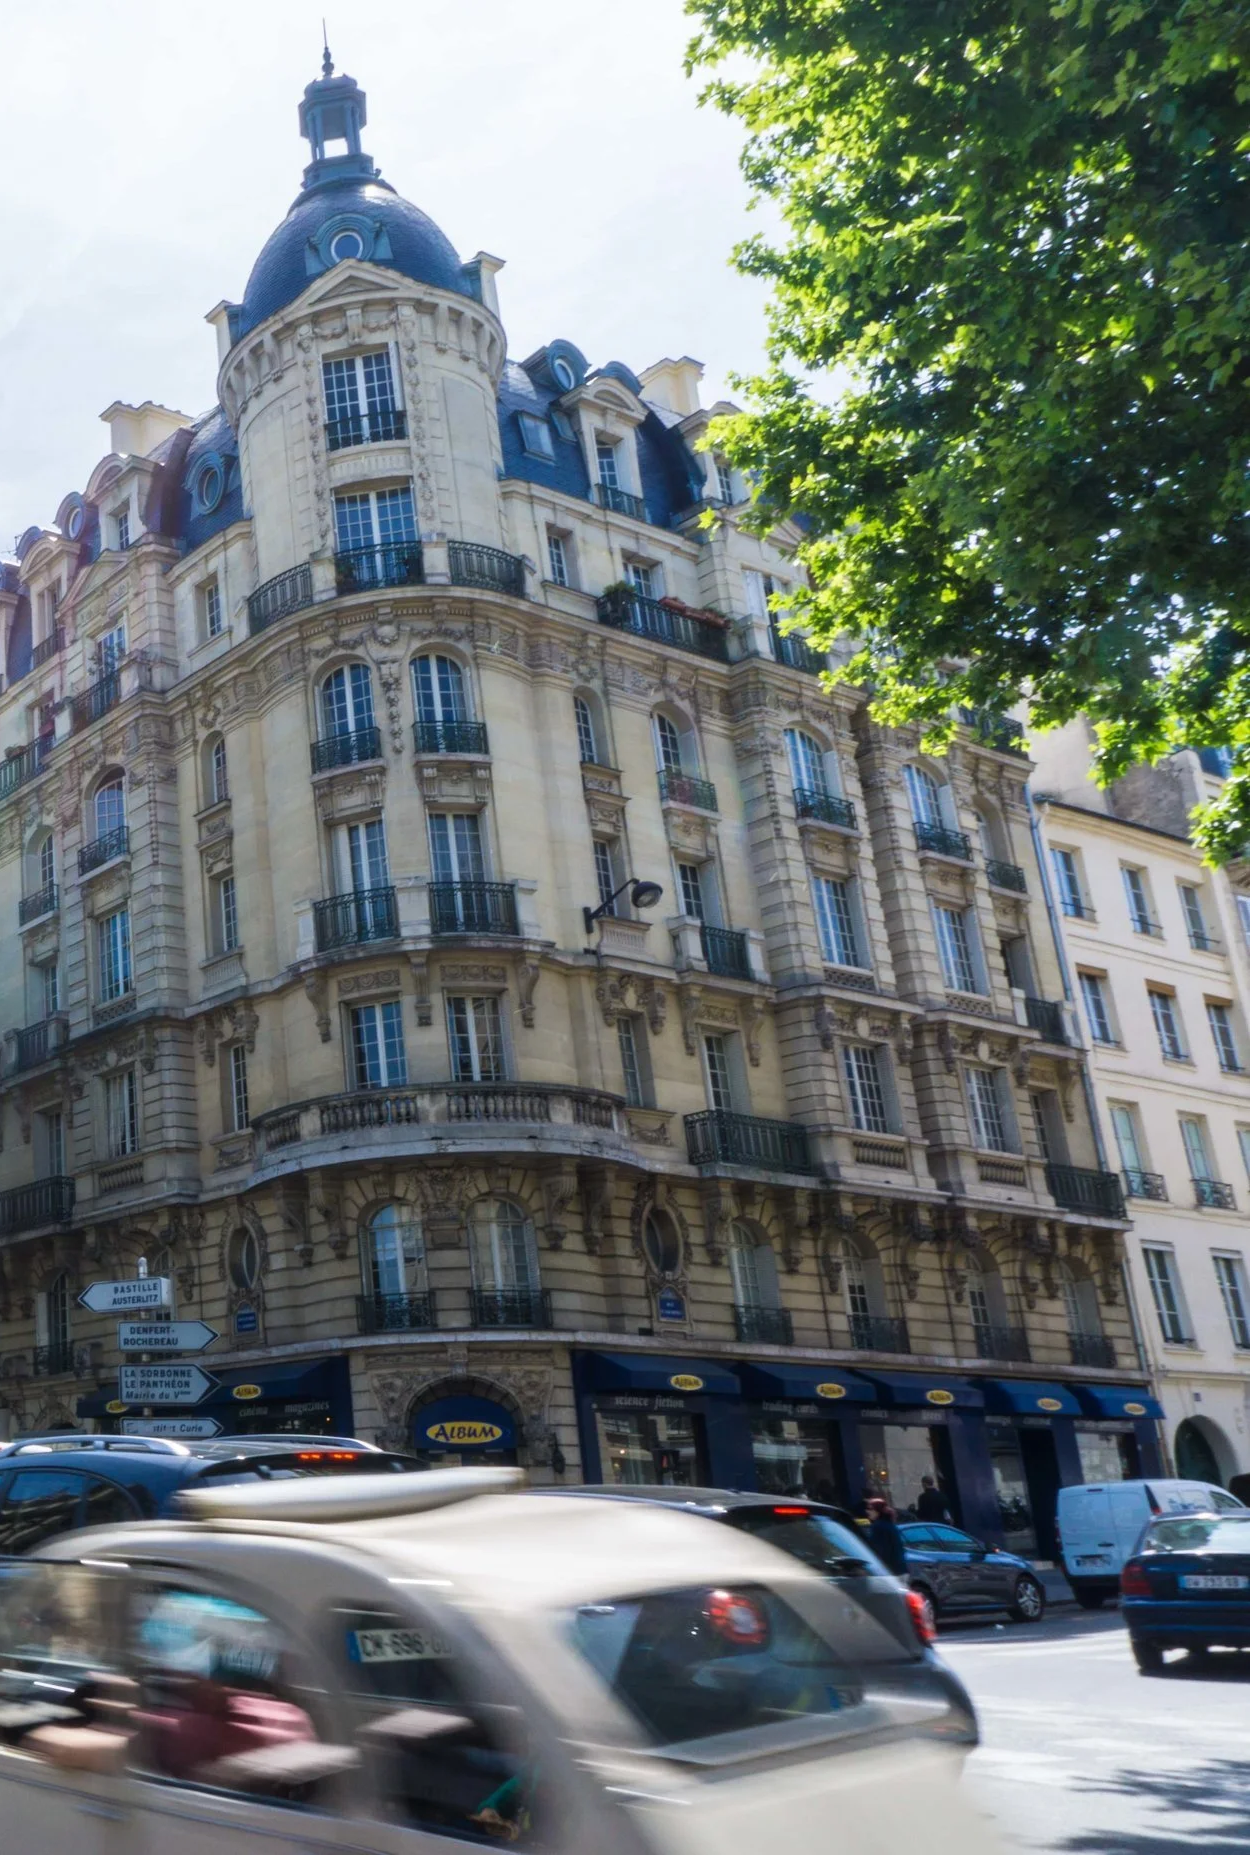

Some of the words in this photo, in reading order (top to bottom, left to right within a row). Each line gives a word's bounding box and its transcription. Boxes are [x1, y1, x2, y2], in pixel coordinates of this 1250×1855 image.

[113, 1283, 159, 1295] BASTILLE
[112, 1294, 159, 1306] AUSTERLITZ
[129, 1326, 176, 1335] DENFERT-
[123, 1337, 179, 1347] ROCHEREAU
[124, 1369, 136, 1378] LA
[140, 1369, 193, 1378] SORBONNE
[124, 1380, 136, 1389] LE
[139, 1378, 191, 1389] PANTHÉON
[125, 1391, 155, 1400] Mairie
[159, 1390, 170, 1400] du
[180, 1423, 203, 1433] Curie
[435, 1425, 496, 1442] ALBUM
